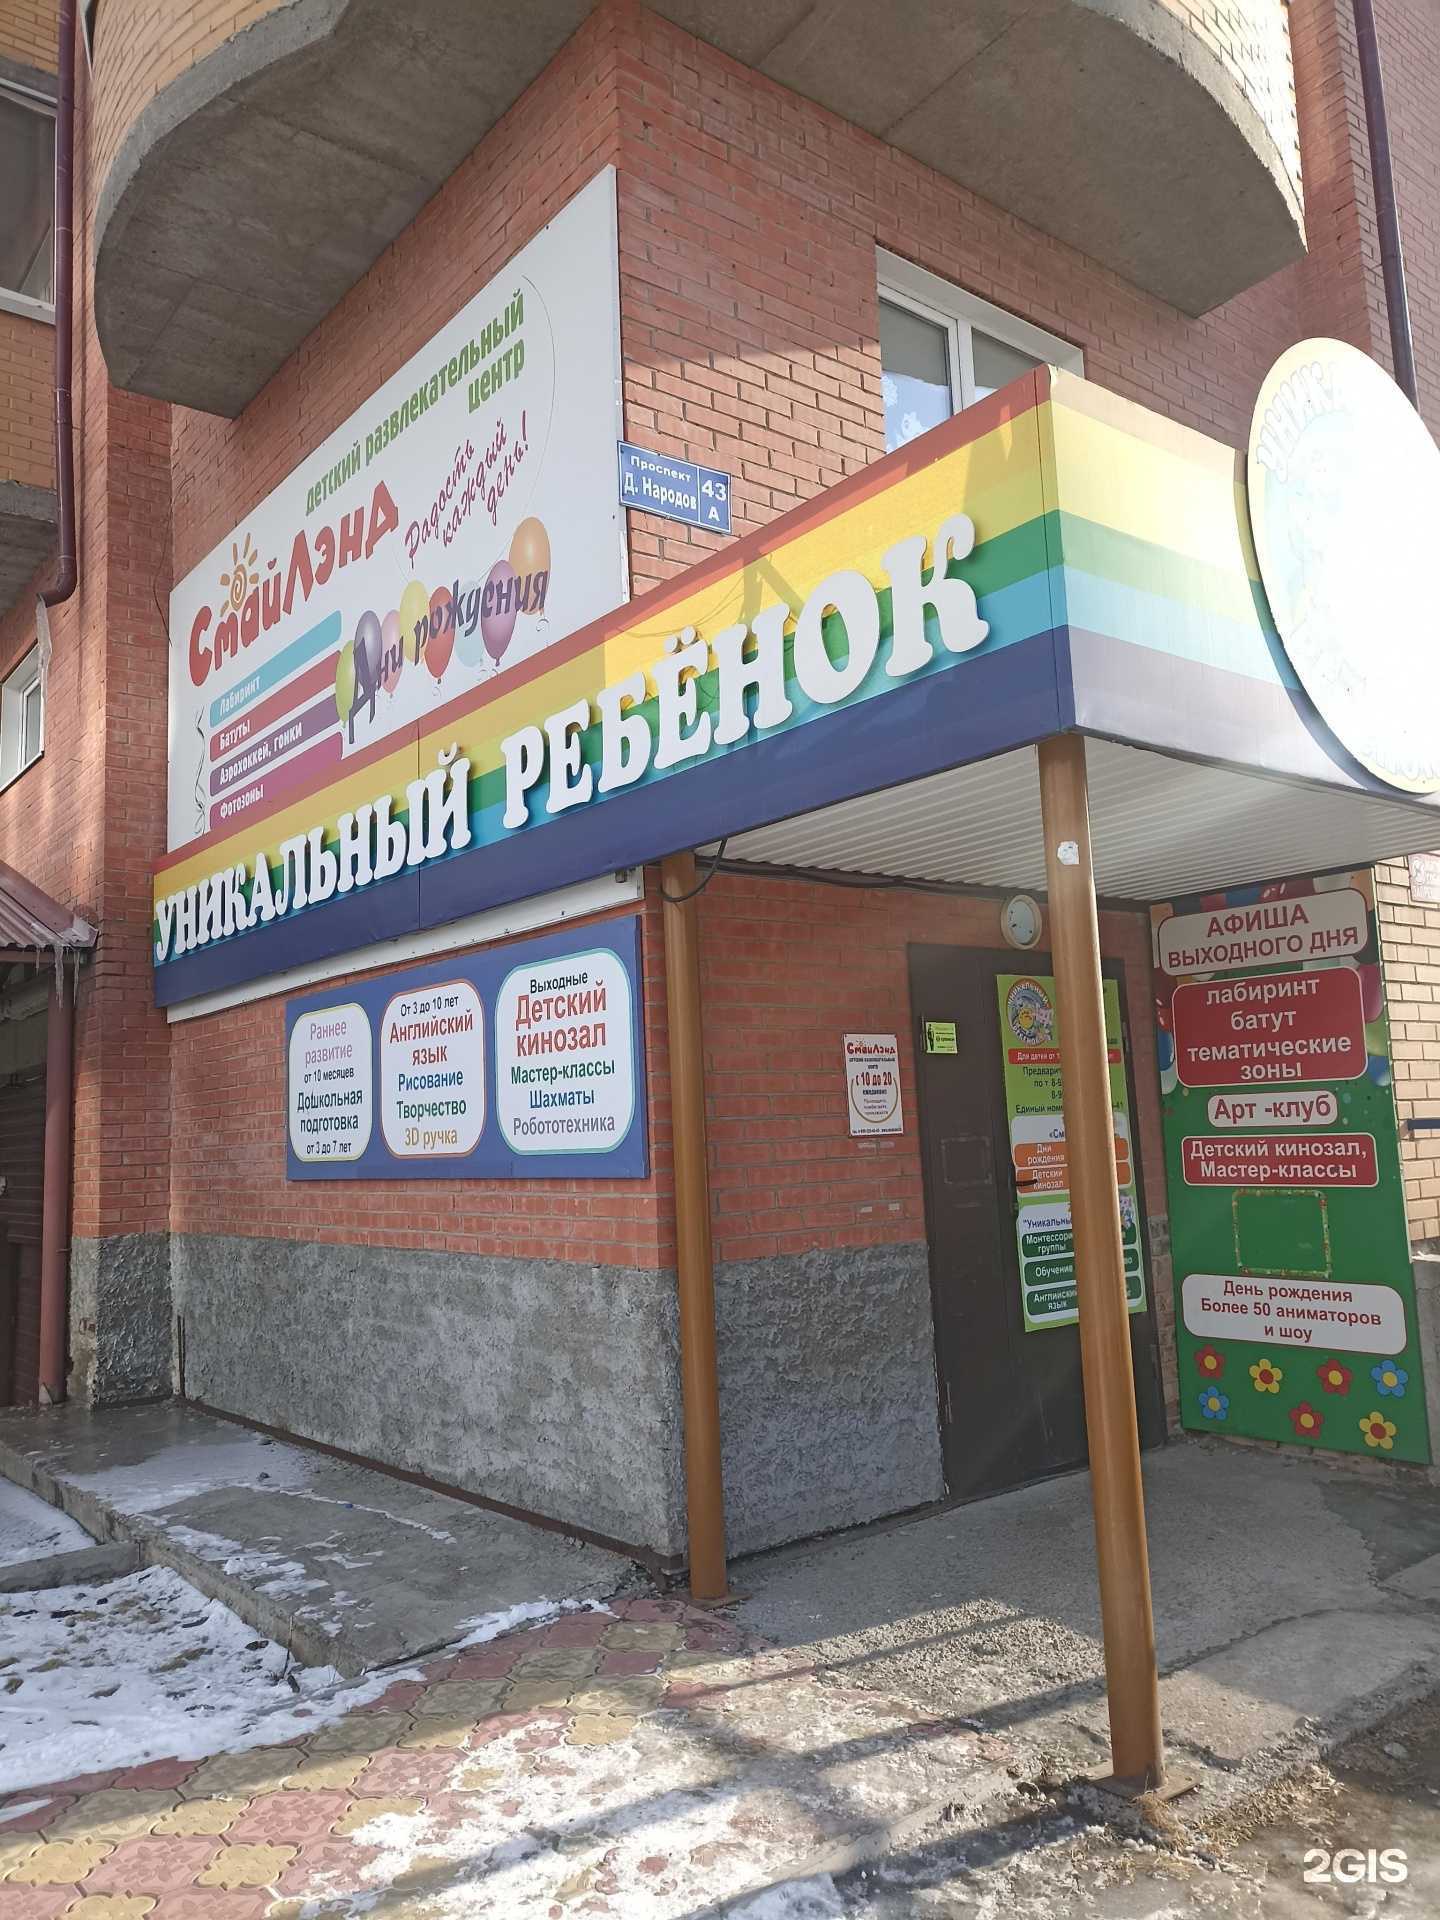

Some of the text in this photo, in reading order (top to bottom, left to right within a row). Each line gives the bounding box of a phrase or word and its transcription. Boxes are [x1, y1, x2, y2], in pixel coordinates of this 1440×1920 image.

[468, 338, 525, 415] центр
[305, 287, 525, 517] детский развлекательный
[485, 410, 530, 527] день!
[630, 455, 727, 502] Проспект 43
[442, 420, 508, 549] каждый
[624, 472, 697, 510] Д. Народов
[405, 438, 475, 568] Радость
[708, 506, 720, 521] А
[348, 569, 549, 745] Дни рождения
[219, 675, 261, 717] Лабиринт
[154, 513, 990, 961] УНИКАЛЬНЫЙ РЕБЁНОК
[219, 719, 251, 751] Батуты
[219, 722, 303, 785] Аэрохоккей, гонки
[220, 784, 264, 819] Фотозоны
[1207, 904, 1309, 938] АФИША
[1168, 926, 1359, 968] ВЫХОДНОГО ДНЯ
[529, 971, 588, 994] Выходные
[1206, 977, 1320, 1006] лабиринт
[400, 995, 459, 1017] От 3 до 10 лет
[515, 979, 607, 1031] Детский
[310, 1021, 347, 1041] Раннее
[389, 1008, 473, 1044] Английский
[1230, 1009, 1297, 1032] батут
[516, 1021, 607, 1058] кинозал
[1187, 1035, 1352, 1062] тематические
[305, 1044, 353, 1068] развитие
[412, 1045, 448, 1066] язык
[304, 1067, 354, 1083] от 10 месяцев
[398, 1071, 464, 1092] Рисование
[511, 1058, 615, 1085] Мастер-классы
[861, 1072, 870, 1086] 10
[872, 1074, 881, 1086] до
[883, 1072, 892, 1086] 20
[1239, 1063, 1303, 1081] зоны
[297, 1089, 363, 1112] Дошкольная
[396, 1097, 466, 1122] Творчество
[529, 1087, 595, 1109] Шахматы
[1015, 1104, 1046, 1114] Единый
[1213, 1098, 1257, 1124] Арт
[300, 1114, 359, 1134] подготовка
[512, 1114, 616, 1137] Робототехника
[306, 1143, 315, 1154] от
[321, 1142, 331, 1154] до
[339, 1142, 352, 1153] лет
[404, 1127, 458, 1151] 3D ручка
[1036, 1144, 1051, 1153] Дни
[1190, 1138, 1368, 1160] Детский кинозал,
[1027, 1150, 1065, 1165] рождения
[1032, 1169, 1062, 1180] Детский
[1200, 1160, 1357, 1181] Мастер-классы
[1033, 1180, 1063, 1190] кинозал
[1038, 1243, 1066, 1255] группы
[1035, 1264, 1073, 1277] Обучение
[1223, 1280, 1353, 1303] День рождения
[1048, 1301, 1067, 1310] язык
[1201, 1298, 1382, 1326] Более 50 аниматоров
[1264, 1325, 1313, 1343] и шоу
